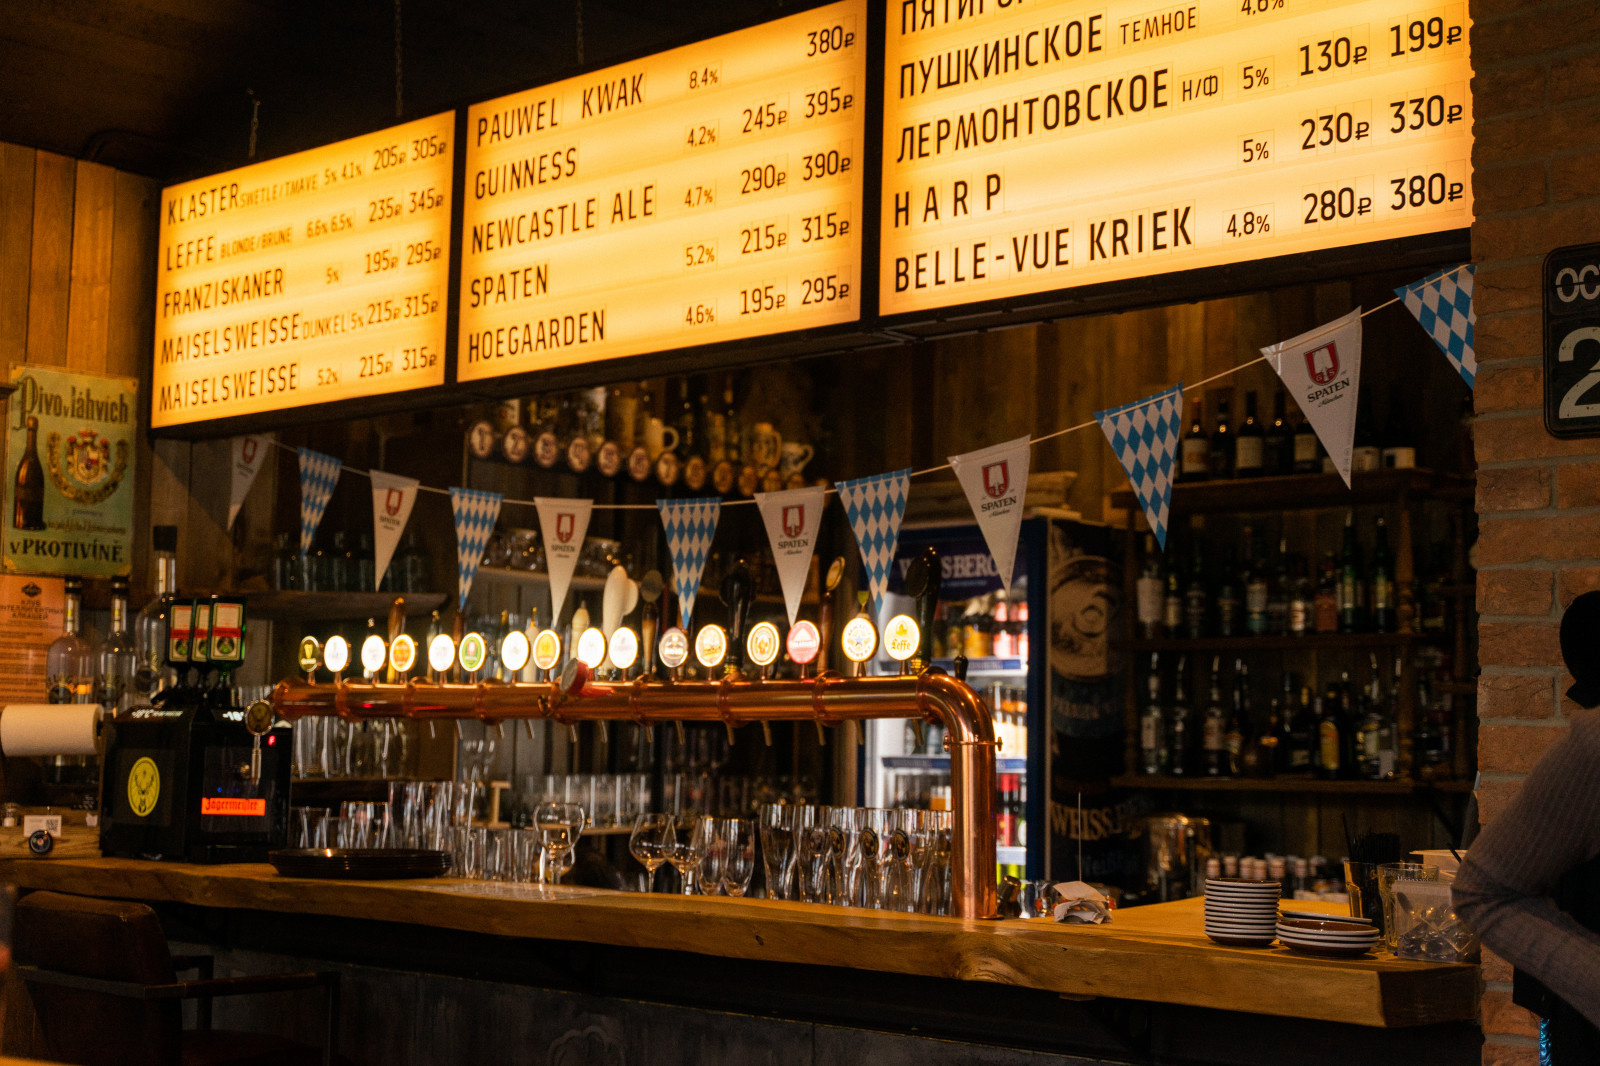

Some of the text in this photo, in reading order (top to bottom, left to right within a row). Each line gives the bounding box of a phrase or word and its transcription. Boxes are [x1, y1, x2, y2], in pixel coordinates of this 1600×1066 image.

[900, 14, 1102, 99] ПУШКИНСКОЕ
[1120, 7, 1197, 45] ТЕМНОЕ
[477, 97, 559, 148] PAUWEL
[581, 73, 644, 120] KWAK
[897, 68, 1168, 163] ЛЕРМОНТОВСКОЕ
[1243, 65, 1269, 90] 5%
[475, 147, 577, 200] GUINNESS
[1243, 138, 1269, 163] 5%
[168, 183, 239, 226] KLASTER
[471, 197, 596, 255] NEWCASTLE
[611, 184, 654, 224] ALE
[166, 236, 214, 271] LEFFE
[895, 228, 1070, 293] BELLE-VUE
[1090, 206, 1192, 261] KRIEK
[163, 268, 284, 318] FRANZISKANER
[471, 263, 549, 308] SPATEN
[469, 309, 606, 364] HOEGAARDEN
[1307, 378, 1350, 402] SPATEN
[981, 496, 1017, 512] SPATEN
[778, 538, 809, 549] SPATEN
